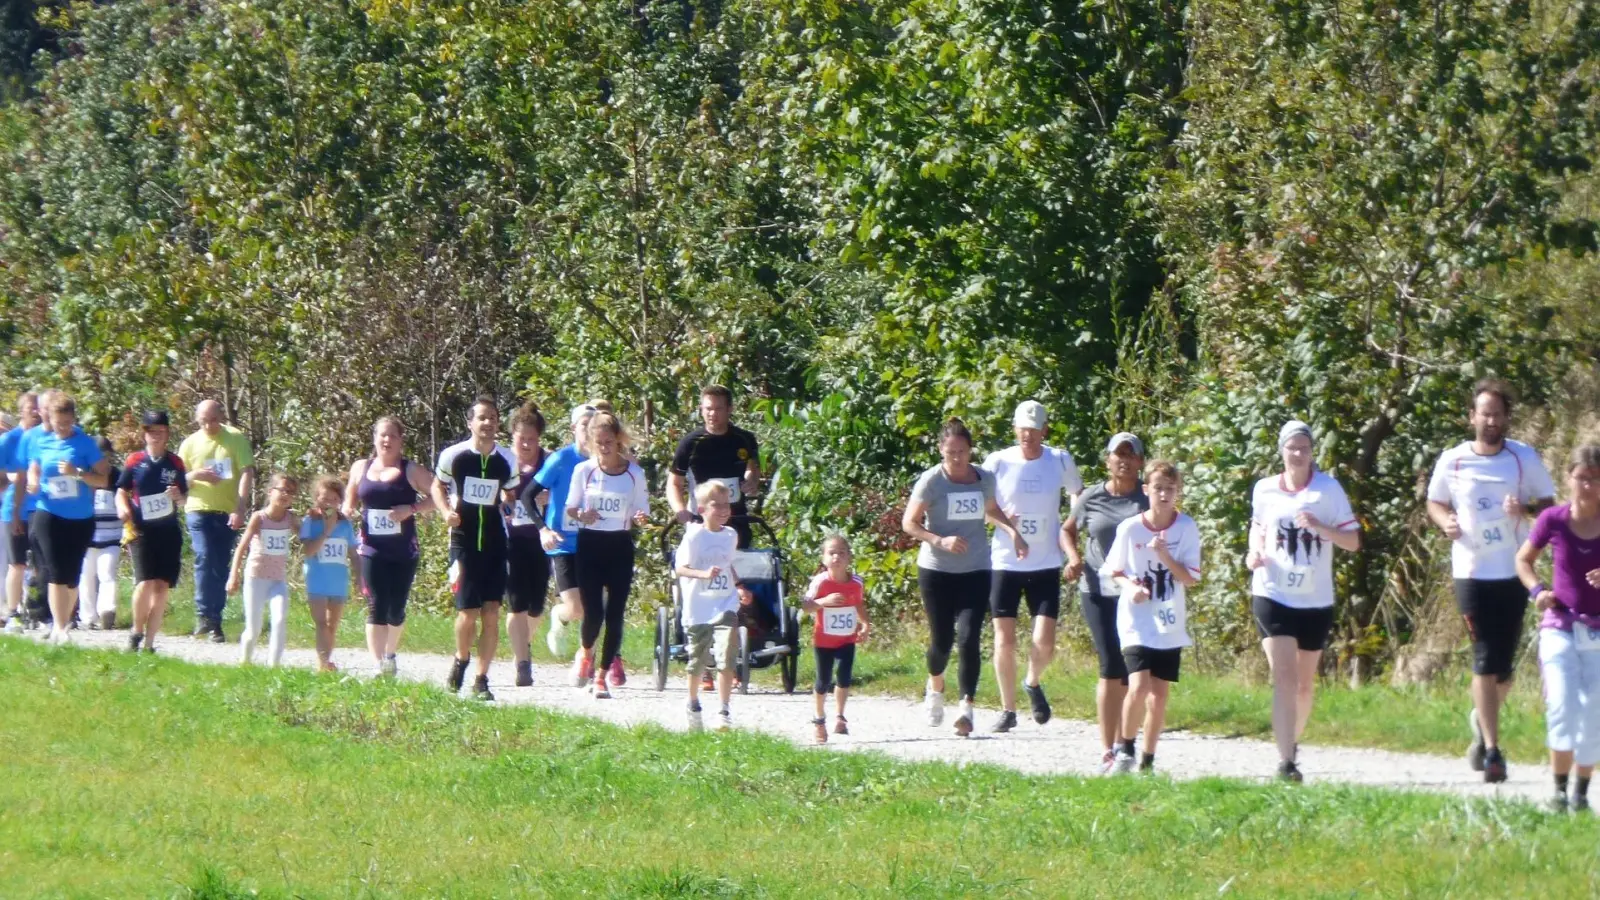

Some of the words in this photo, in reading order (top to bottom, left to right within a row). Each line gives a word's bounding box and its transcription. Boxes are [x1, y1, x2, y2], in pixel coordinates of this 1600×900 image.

[471, 483, 492, 499] 107
[147, 497, 168, 513] 139
[597, 496, 621, 512] 108
[955, 498, 978, 514] 258
[1021, 519, 1038, 535] 55
[267, 535, 286, 550] 315
[1482, 527, 1503, 545] 94
[324, 543, 343, 558] 314
[707, 574, 728, 590] 292
[1287, 571, 1305, 588] 97
[830, 613, 853, 629] 256
[1158, 607, 1176, 626] 96
